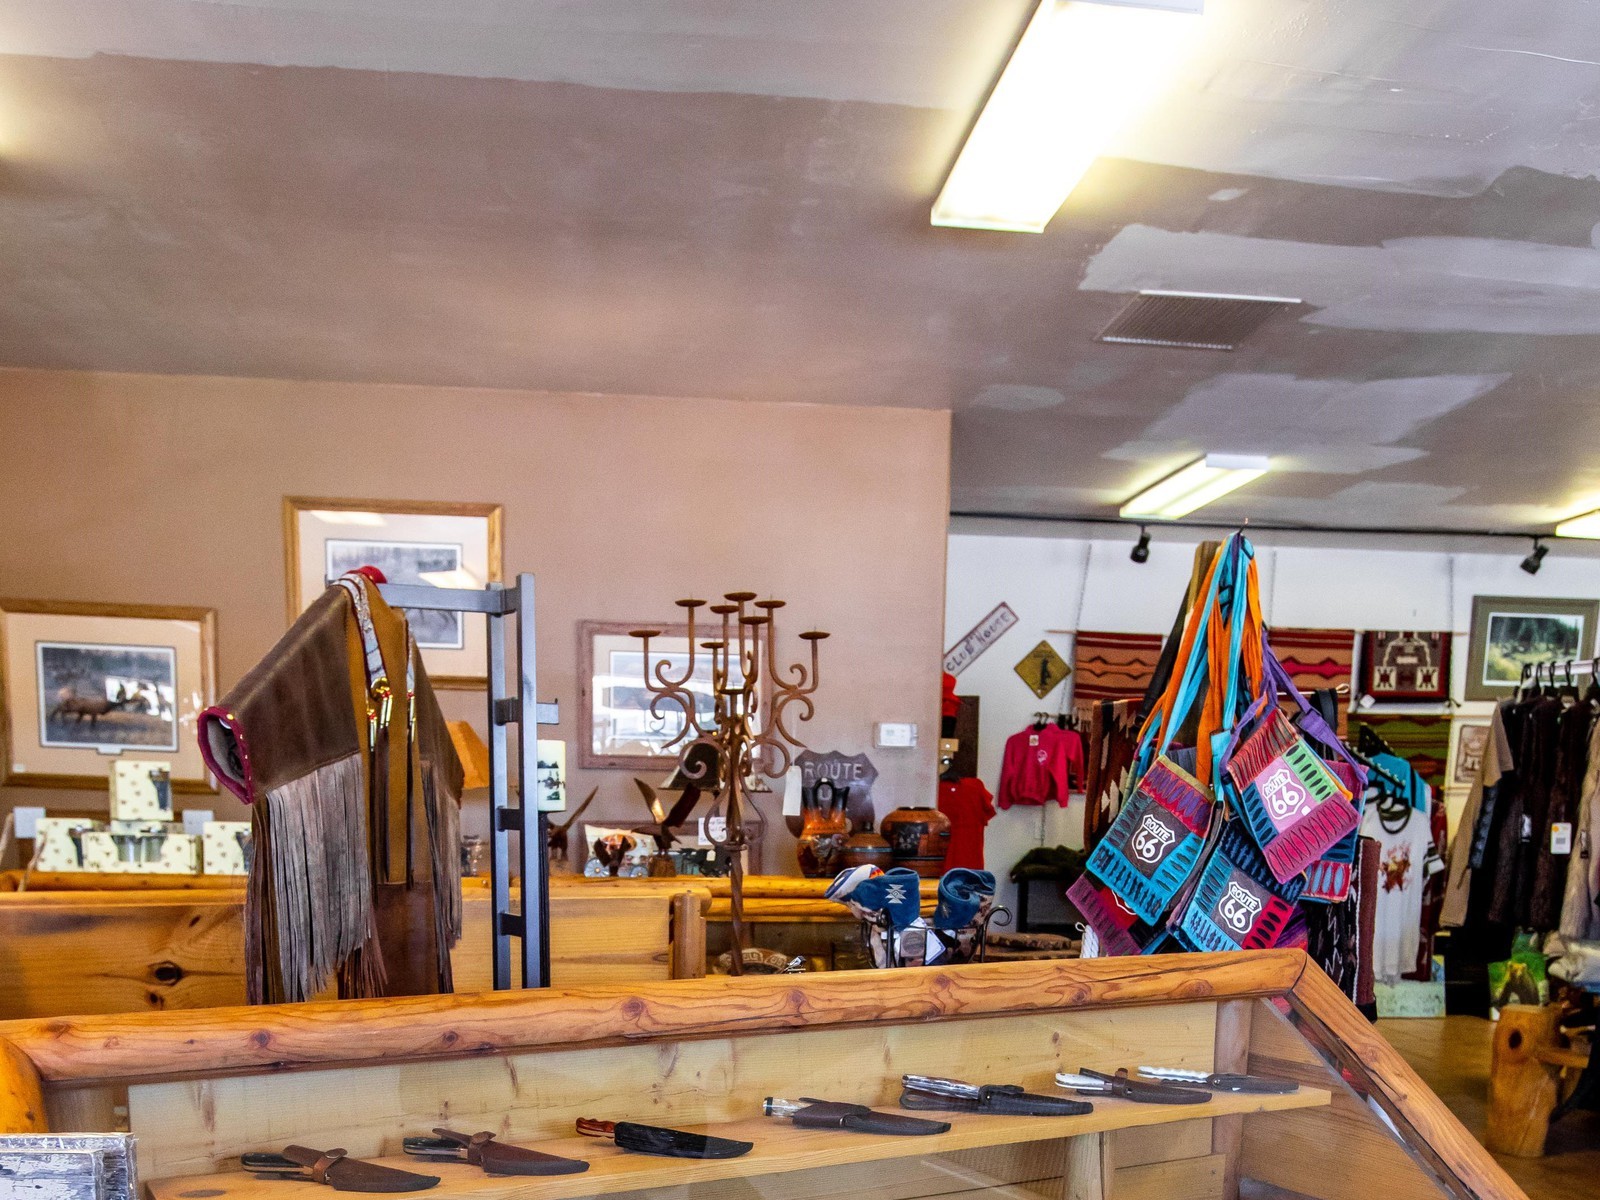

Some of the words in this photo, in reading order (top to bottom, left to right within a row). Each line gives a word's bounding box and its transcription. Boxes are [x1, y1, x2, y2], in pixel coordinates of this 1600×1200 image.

[804, 761, 863, 780] ROUTE
[1264, 773, 1288, 796] ROUTE
[1272, 785, 1300, 815] 66
[1145, 818, 1170, 841] ROUTE
[1136, 830, 1159, 858] 66
[1231, 885, 1258, 910] ROUTE
[1224, 899, 1247, 928] 66
